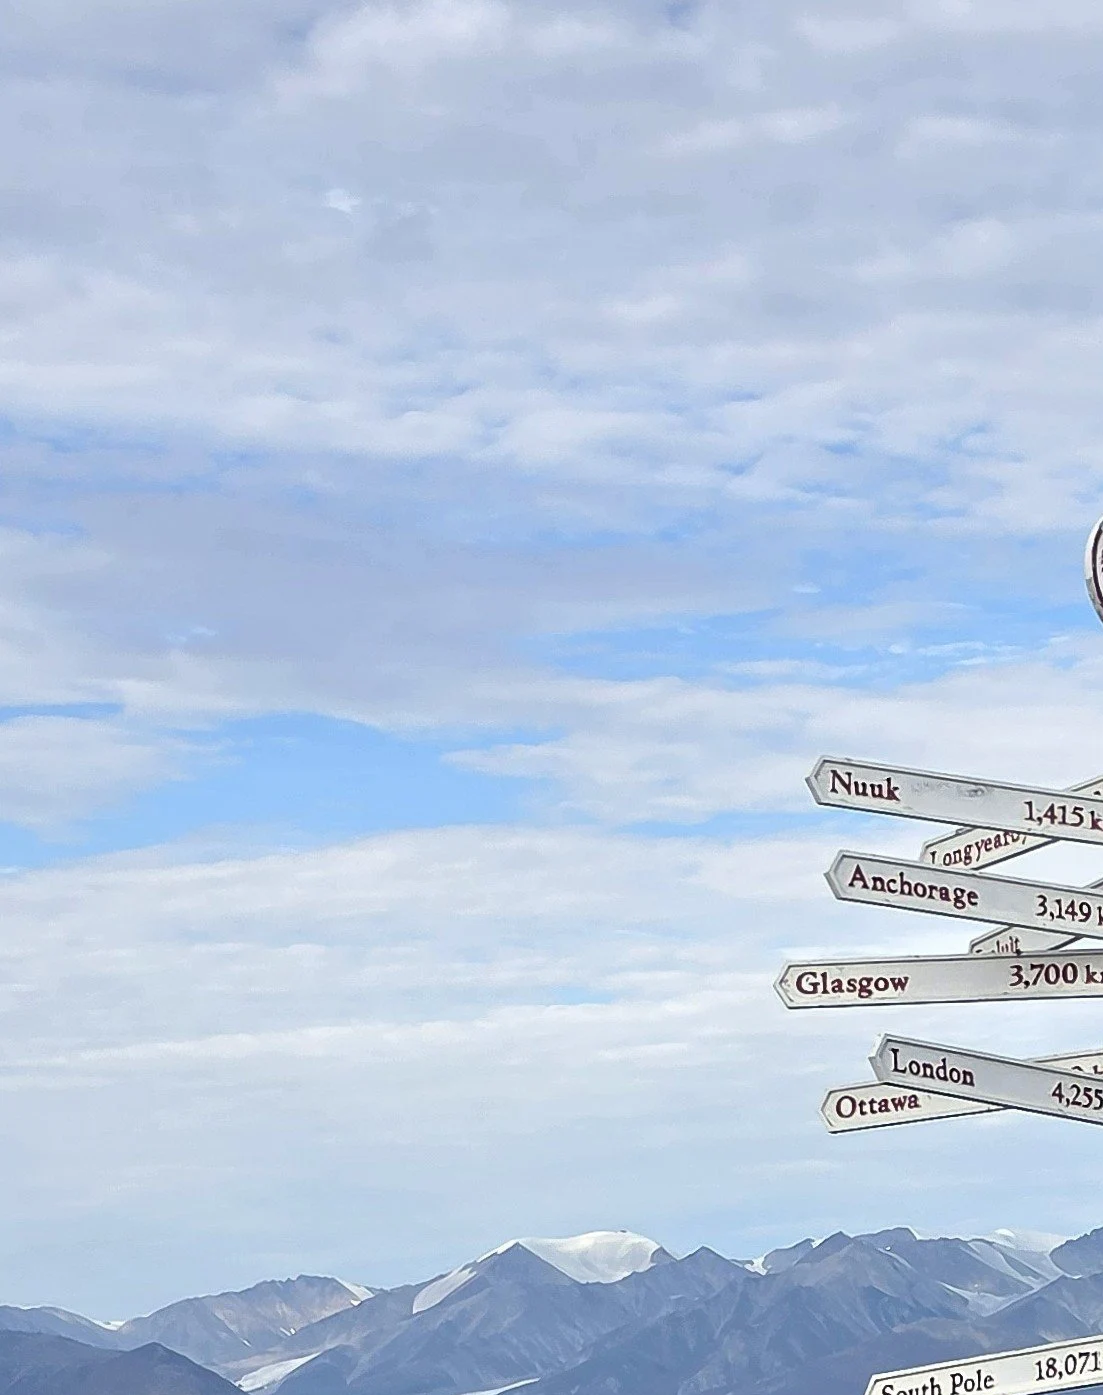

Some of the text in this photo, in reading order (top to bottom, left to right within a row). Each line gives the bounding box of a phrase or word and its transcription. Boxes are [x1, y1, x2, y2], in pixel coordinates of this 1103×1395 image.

[829, 770, 900, 801] Nuuk
[1024, 801, 1085, 827] 1,415
[848, 864, 979, 910] Anchorage
[1036, 894, 1092, 923] 3,149
[795, 972, 910, 1001] Glasgow
[1009, 963, 1079, 987] 3,700
[891, 1048, 976, 1087] London
[835, 1094, 921, 1119] Ottawa
[949, 1369, 995, 1395] Pole
[1034, 1351, 1102, 1382] 18,071
